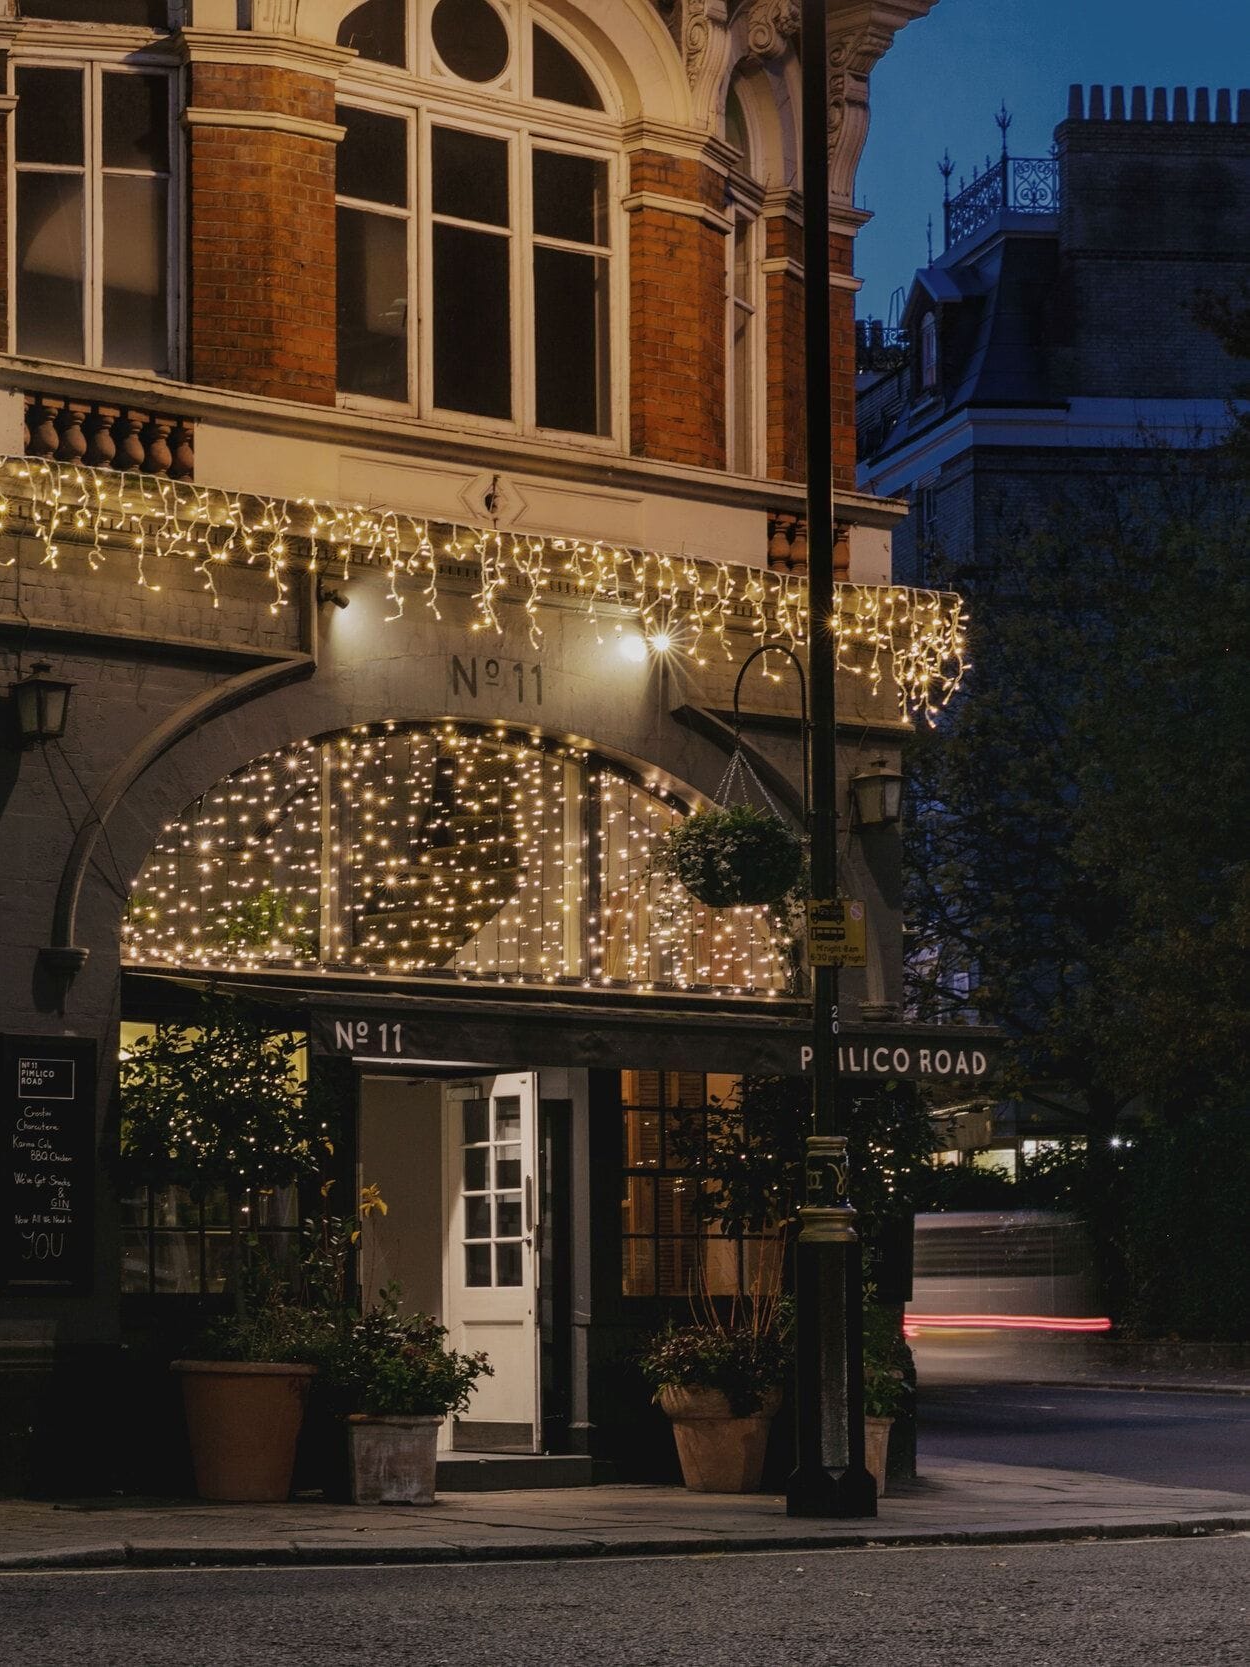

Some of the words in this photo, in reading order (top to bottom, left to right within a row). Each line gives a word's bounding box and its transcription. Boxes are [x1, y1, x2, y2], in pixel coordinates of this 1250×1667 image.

[513, 662, 543, 706] 11
[378, 1022, 402, 1053] 11
[800, 1045, 910, 1074] PLICO
[919, 1048, 987, 1075] ROAD
[21, 1069, 55, 1078] PIMLICO
[21, 1077, 43, 1085] ROAD
[30, 1150, 49, 1161] BBQ
[49, 1152, 72, 1162] Chicken
[50, 1198, 70, 1208] GIN
[21, 1231, 64, 1260] YOU
